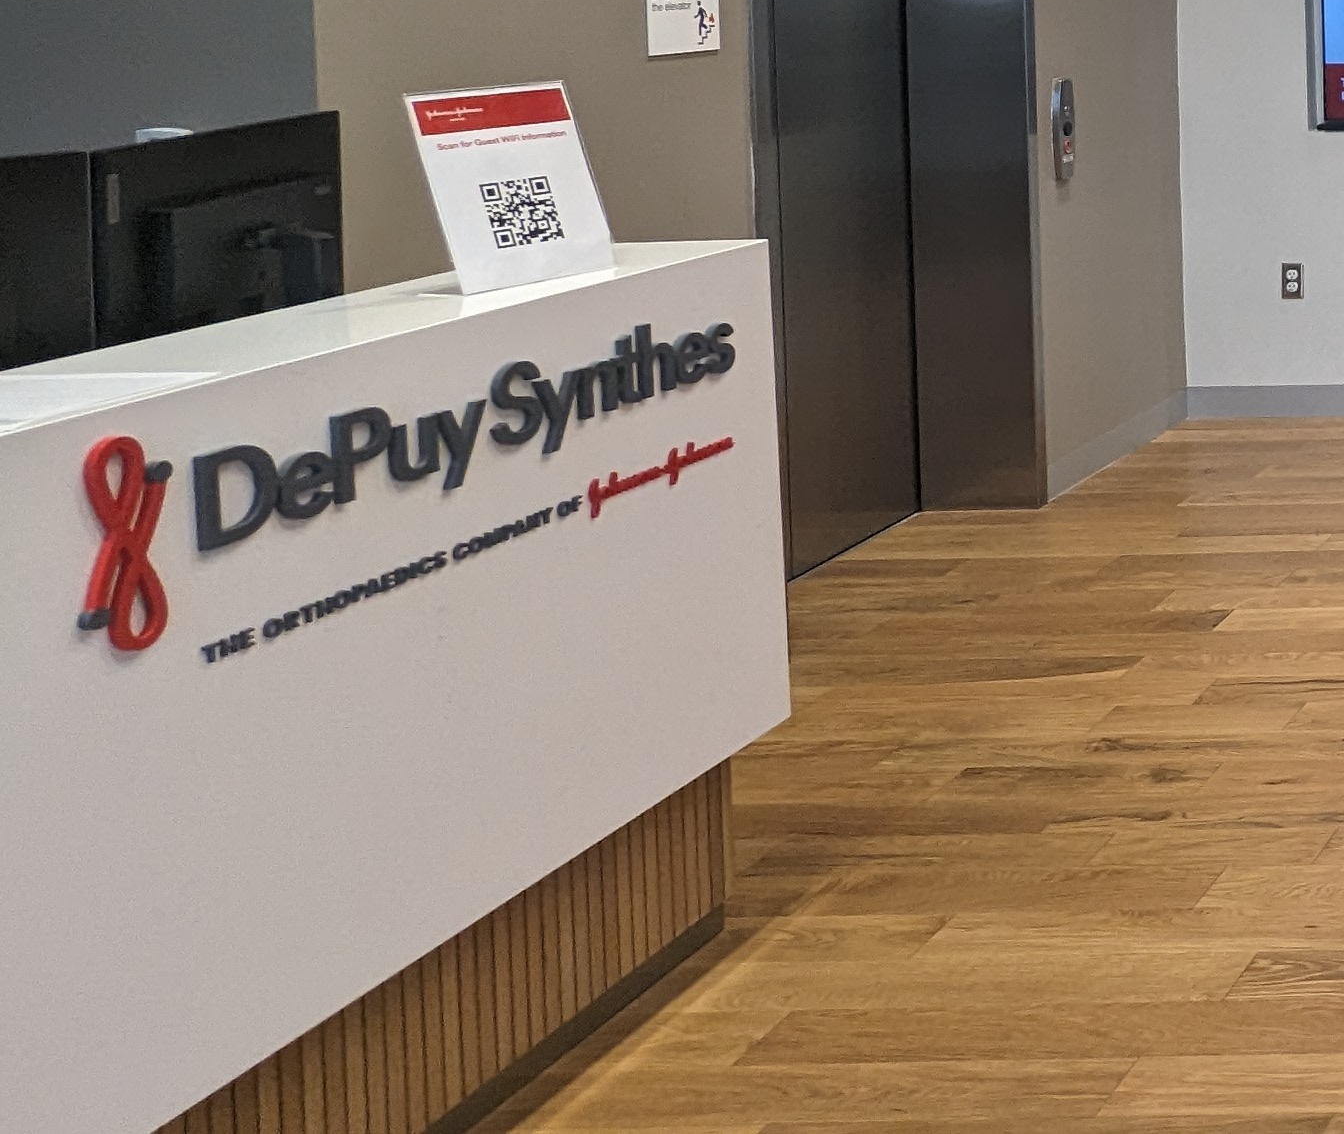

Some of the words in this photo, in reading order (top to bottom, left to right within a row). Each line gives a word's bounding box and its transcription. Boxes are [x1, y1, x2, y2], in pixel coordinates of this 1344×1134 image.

[437, 142, 459, 150] Scan
[474, 137, 500, 146] Guest
[193, 398, 488, 552] DePuy
[489, 322, 736, 455] Synthes
[201, 626, 257, 664] THE
[262, 550, 448, 638] ORTHOPAEDICS
[452, 506, 554, 560] COMPANY
[556, 494, 584, 517] OF
